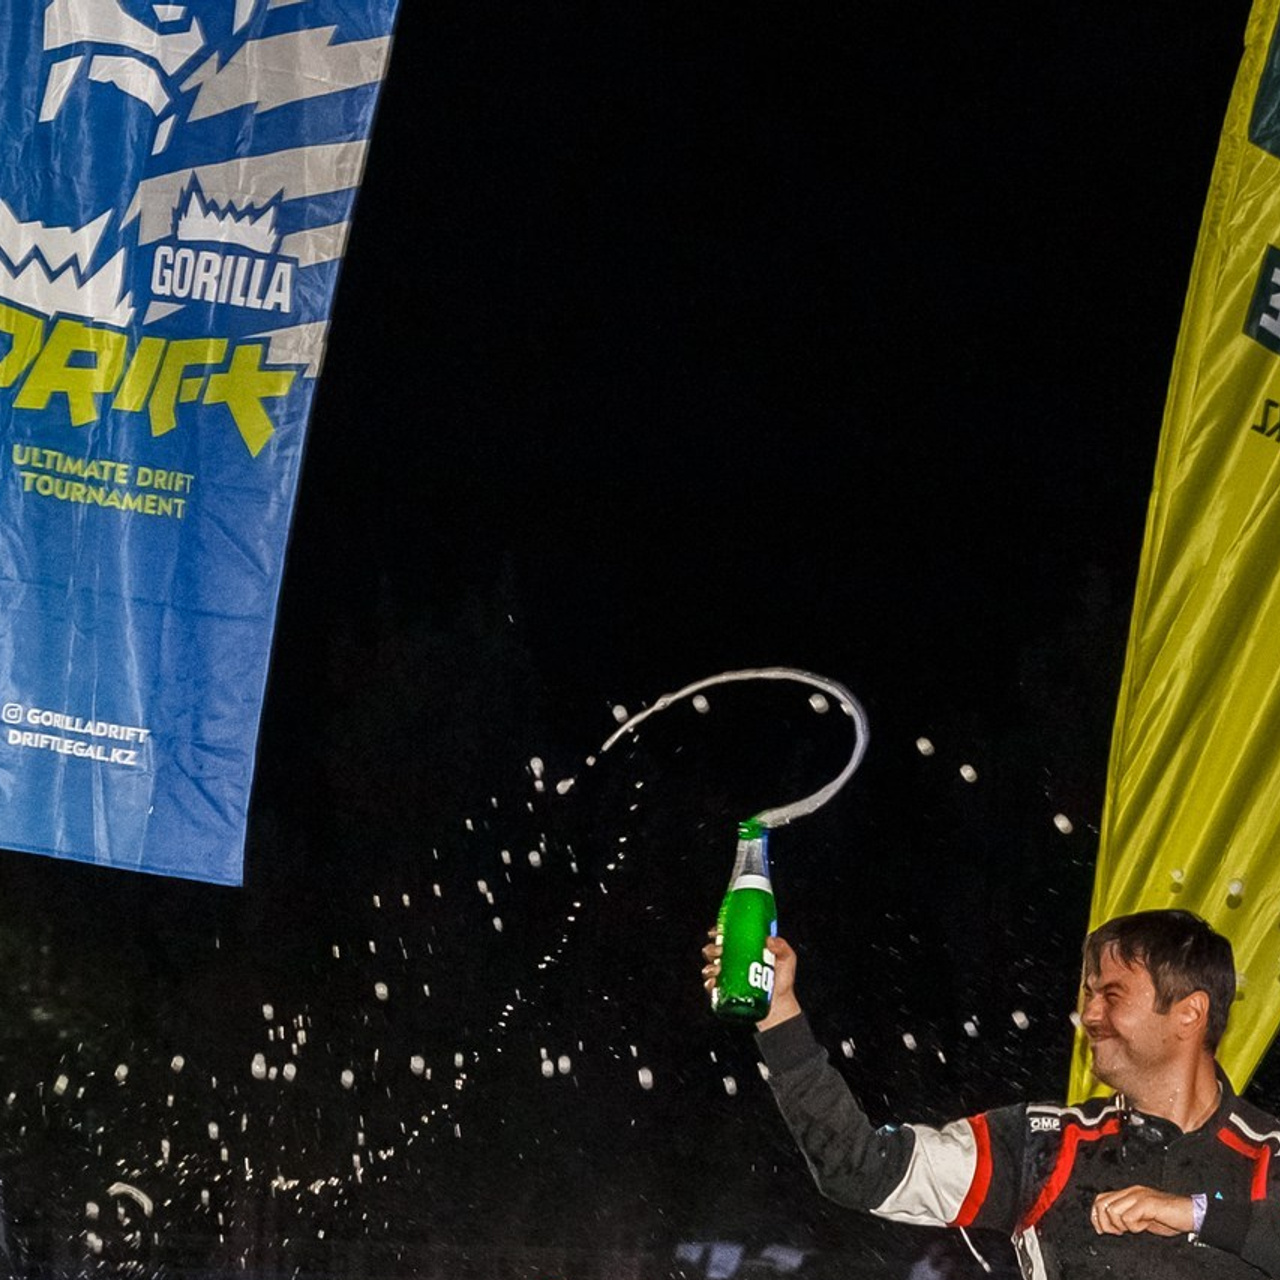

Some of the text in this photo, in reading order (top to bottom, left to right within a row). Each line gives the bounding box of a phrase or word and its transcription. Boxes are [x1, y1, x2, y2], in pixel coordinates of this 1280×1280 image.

[151, 245, 295, 313] GORILLA
[12, 444, 195, 494] ULTIMATE DRIFT
[20, 471, 186, 519] TOURNAMENT
[8, 729, 138, 765] DRIFTLEGAL.KZ
[27, 708, 151, 743] GORILLADRIFT
